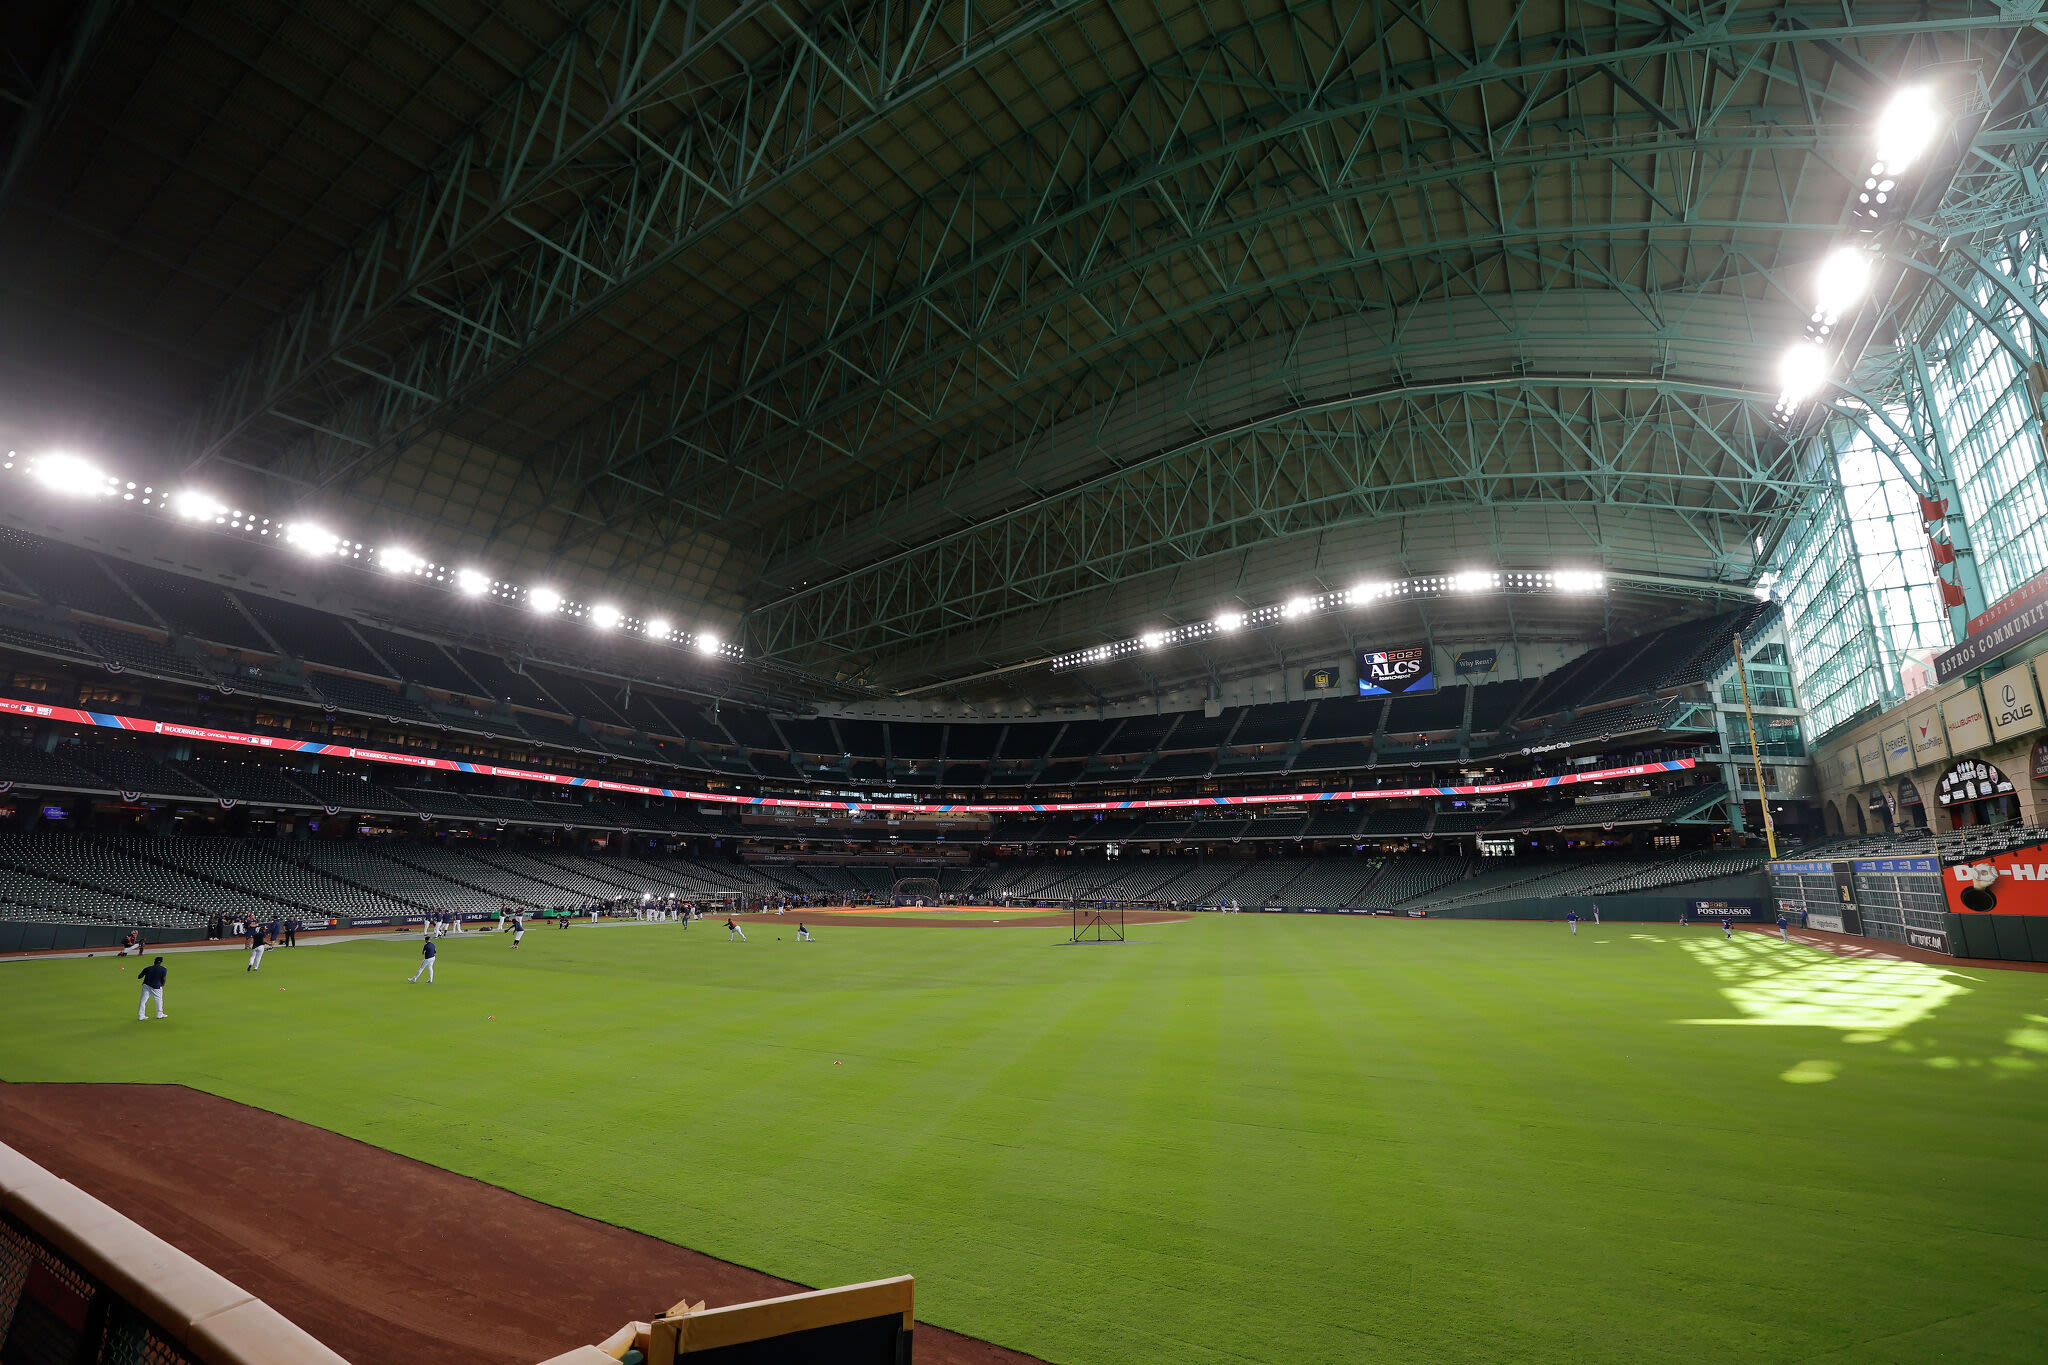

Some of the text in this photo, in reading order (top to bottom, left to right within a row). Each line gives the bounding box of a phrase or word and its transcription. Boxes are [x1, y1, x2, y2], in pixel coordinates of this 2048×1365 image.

[1978, 598, 2016, 627] MINUTE
[1388, 650, 1422, 660] 2023
[1940, 645, 1976, 675] ASTROS
[1371, 660, 1421, 677] ALCS
[1459, 660, 1474, 668] Why
[1948, 712, 1983, 732] HALLIBURTON
[1995, 704, 2033, 727] LEXUS
[164, 725, 206, 737] WOODBRIDGE
[1531, 741, 1571, 754] Gallagher Club
